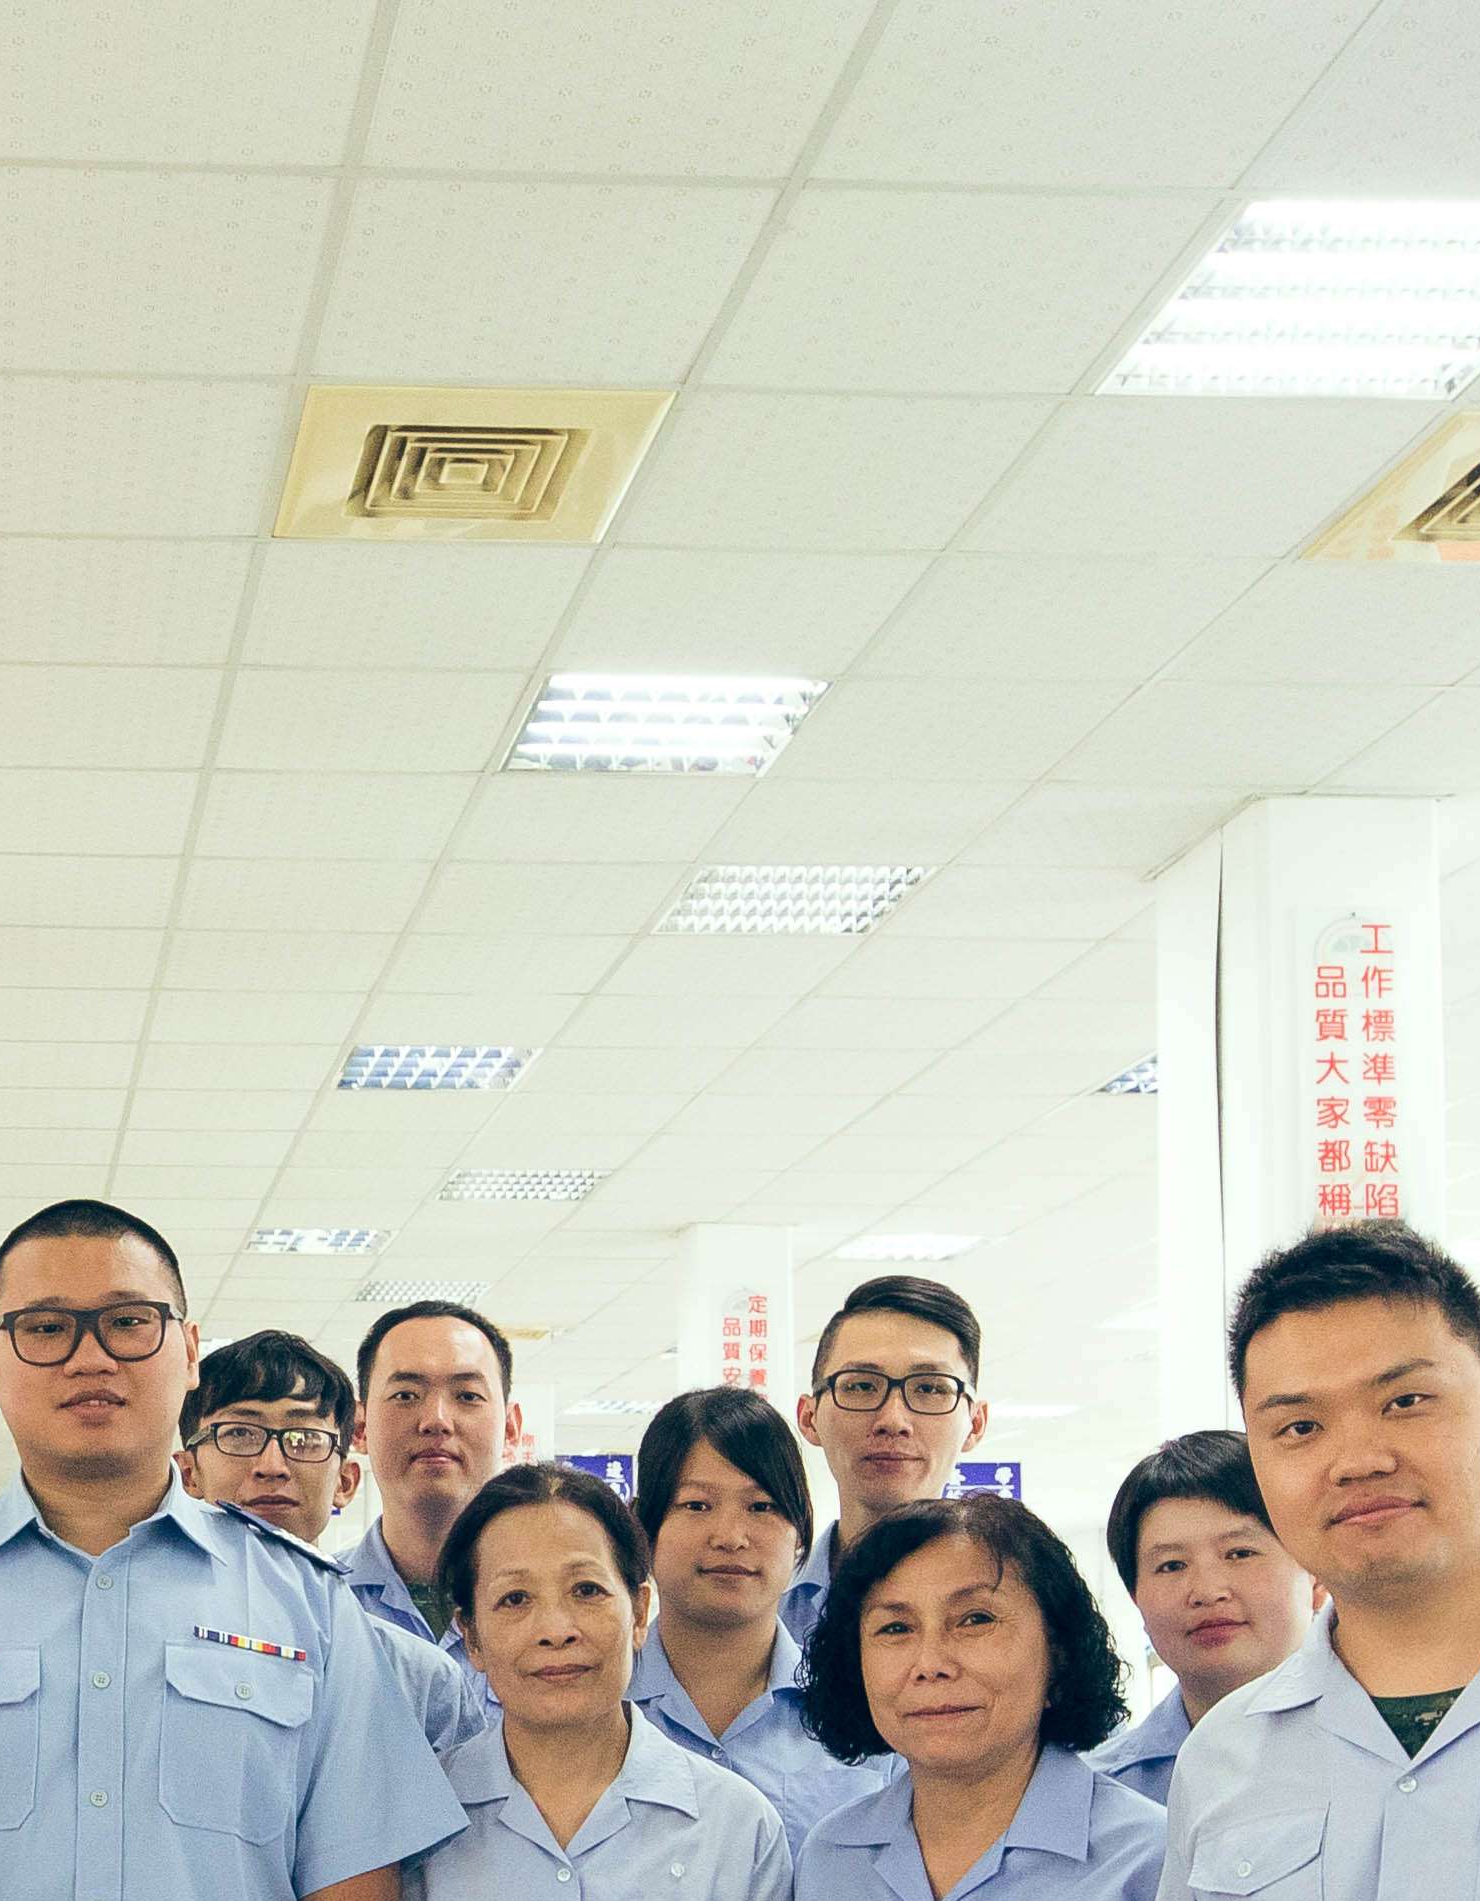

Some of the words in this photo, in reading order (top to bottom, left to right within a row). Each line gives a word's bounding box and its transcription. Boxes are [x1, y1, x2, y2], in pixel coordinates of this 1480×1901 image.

[1360, 923, 1400, 1217] 工作標準零缺陷
[748, 1294, 769, 1401] 定期保養
